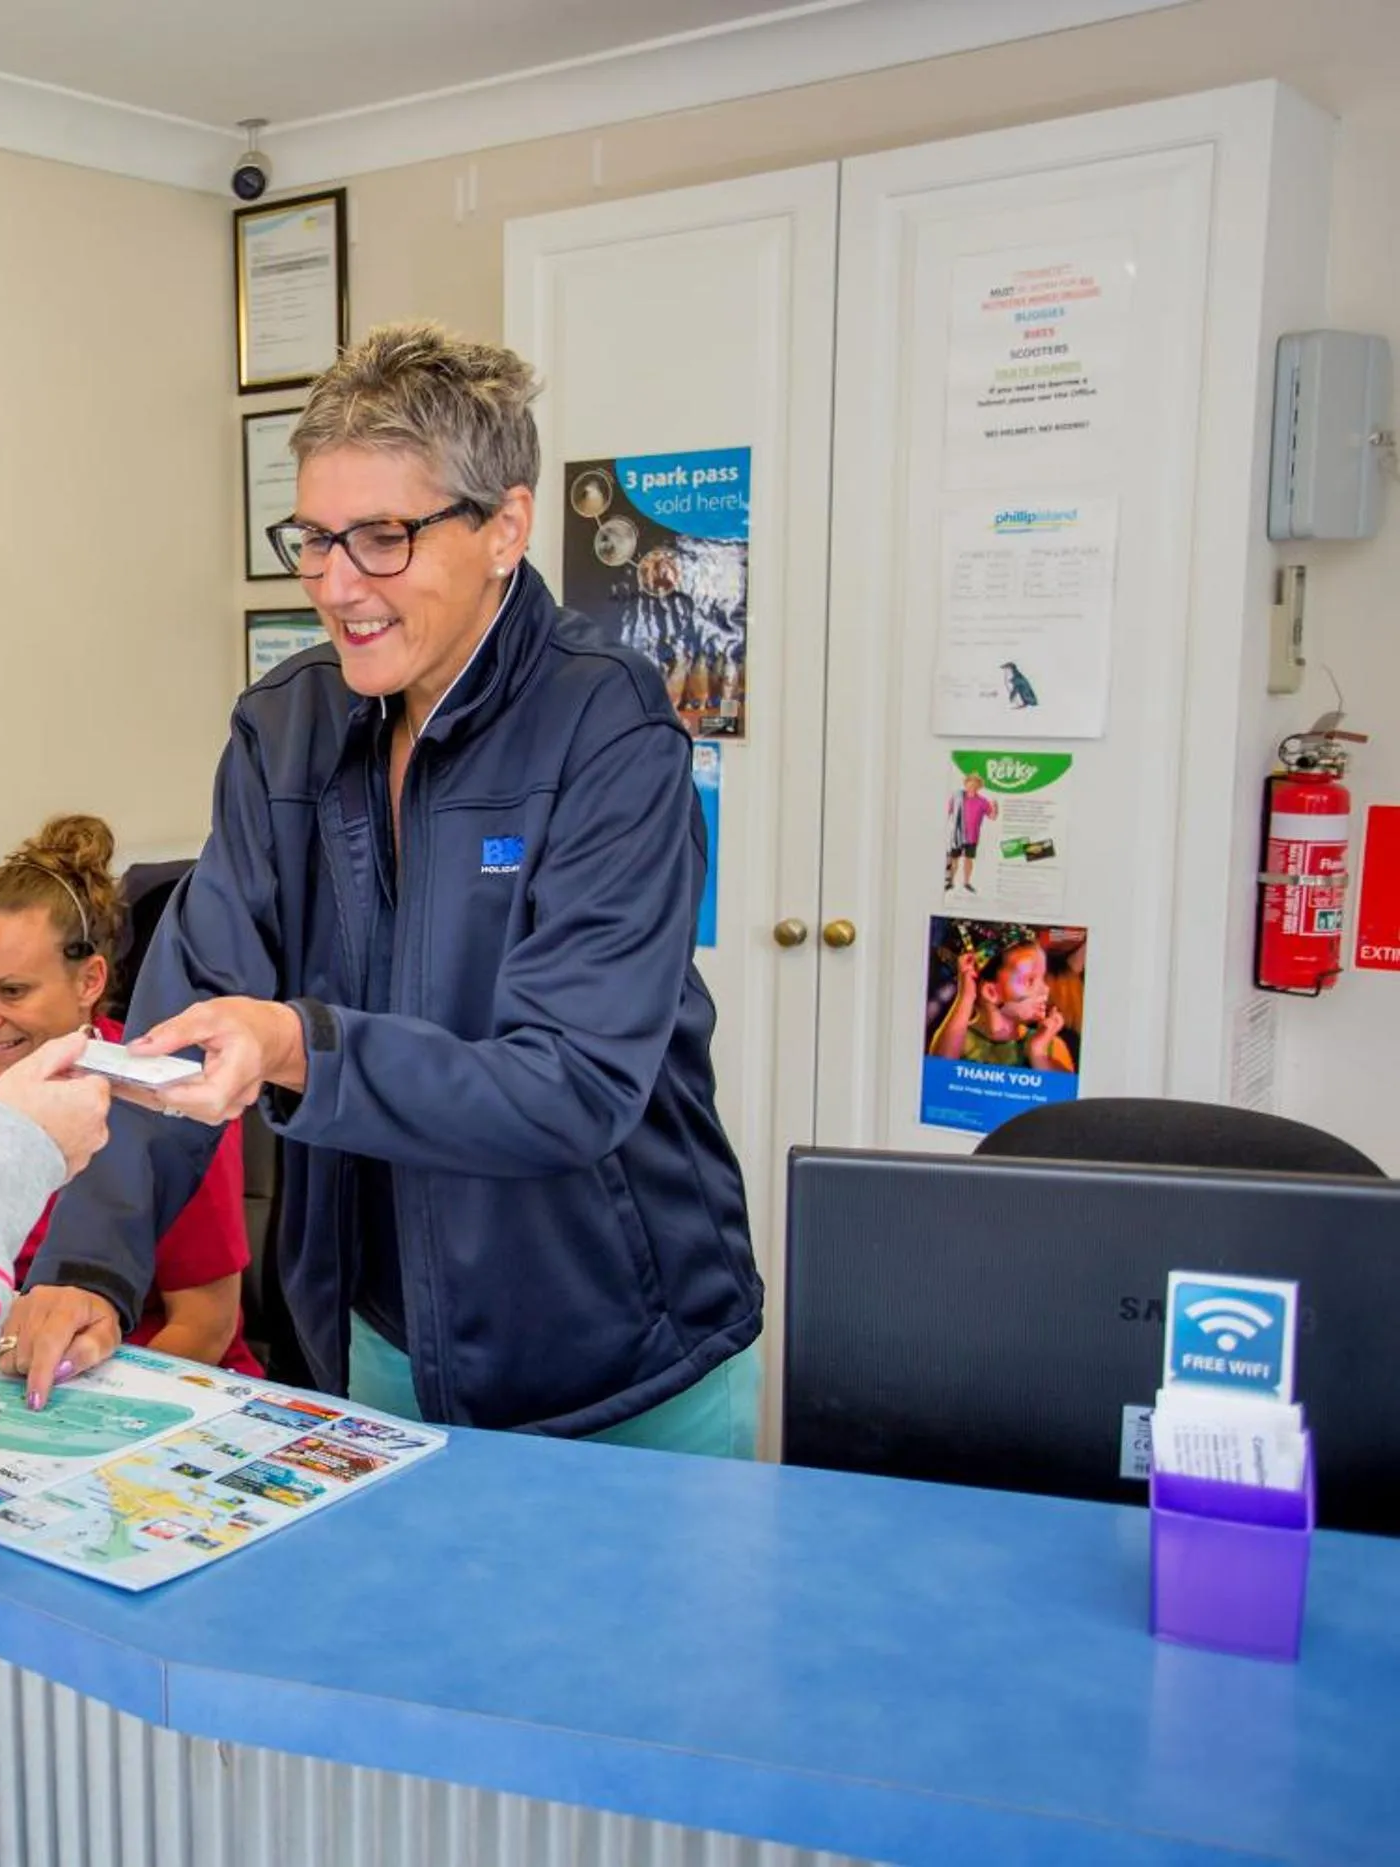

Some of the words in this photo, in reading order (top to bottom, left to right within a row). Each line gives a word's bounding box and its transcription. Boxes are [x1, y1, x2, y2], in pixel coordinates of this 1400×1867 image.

[1010, 344, 1069, 359] SCOOTERS
[625, 470, 638, 489] 3
[642, 464, 688, 493] park
[692, 465, 739, 489] pass
[654, 492, 692, 515] sold
[955, 1065, 1005, 1084] THANK
[1008, 1072, 1042, 1088] YOU
[1182, 1353, 1227, 1373] FREE
[1227, 1359, 1271, 1379] WIFI
